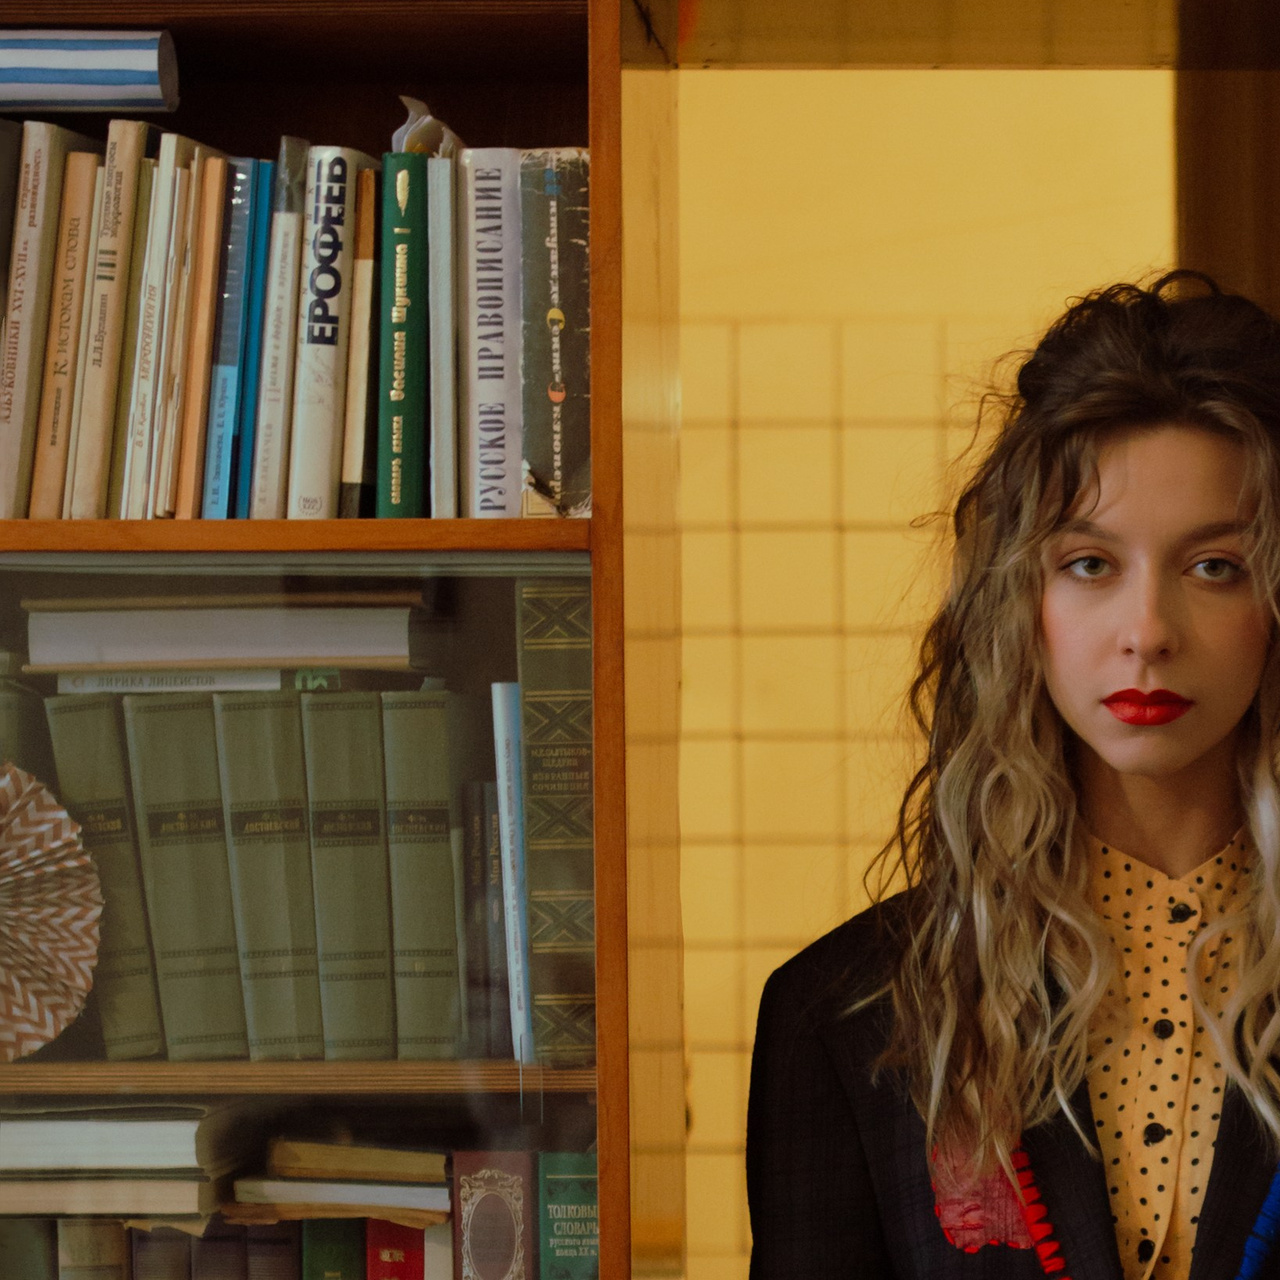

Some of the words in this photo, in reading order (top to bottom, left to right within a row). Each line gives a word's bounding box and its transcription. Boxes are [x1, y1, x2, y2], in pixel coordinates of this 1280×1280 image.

[20, 163, 31, 210] старшая
[28, 148, 42, 228] разновидность
[103, 141, 117, 188] вопросы
[99, 190, 112, 238] Трудные
[108, 171, 123, 238] морфологии
[306, 157, 347, 346] ЕРОФЕЕВ
[473, 167, 506, 381] ПРАВОПИСАНИЕ
[477, 403, 506, 511] РУССКОЕ
[97, 675, 145, 687] ЛИРИКА
[149, 675, 217, 687] ЛИЦЕИСТОВ
[547, 1204, 598, 1219] ТОЛКОВЫ
[553, 1222, 599, 1236] СЛОВАРЬ
